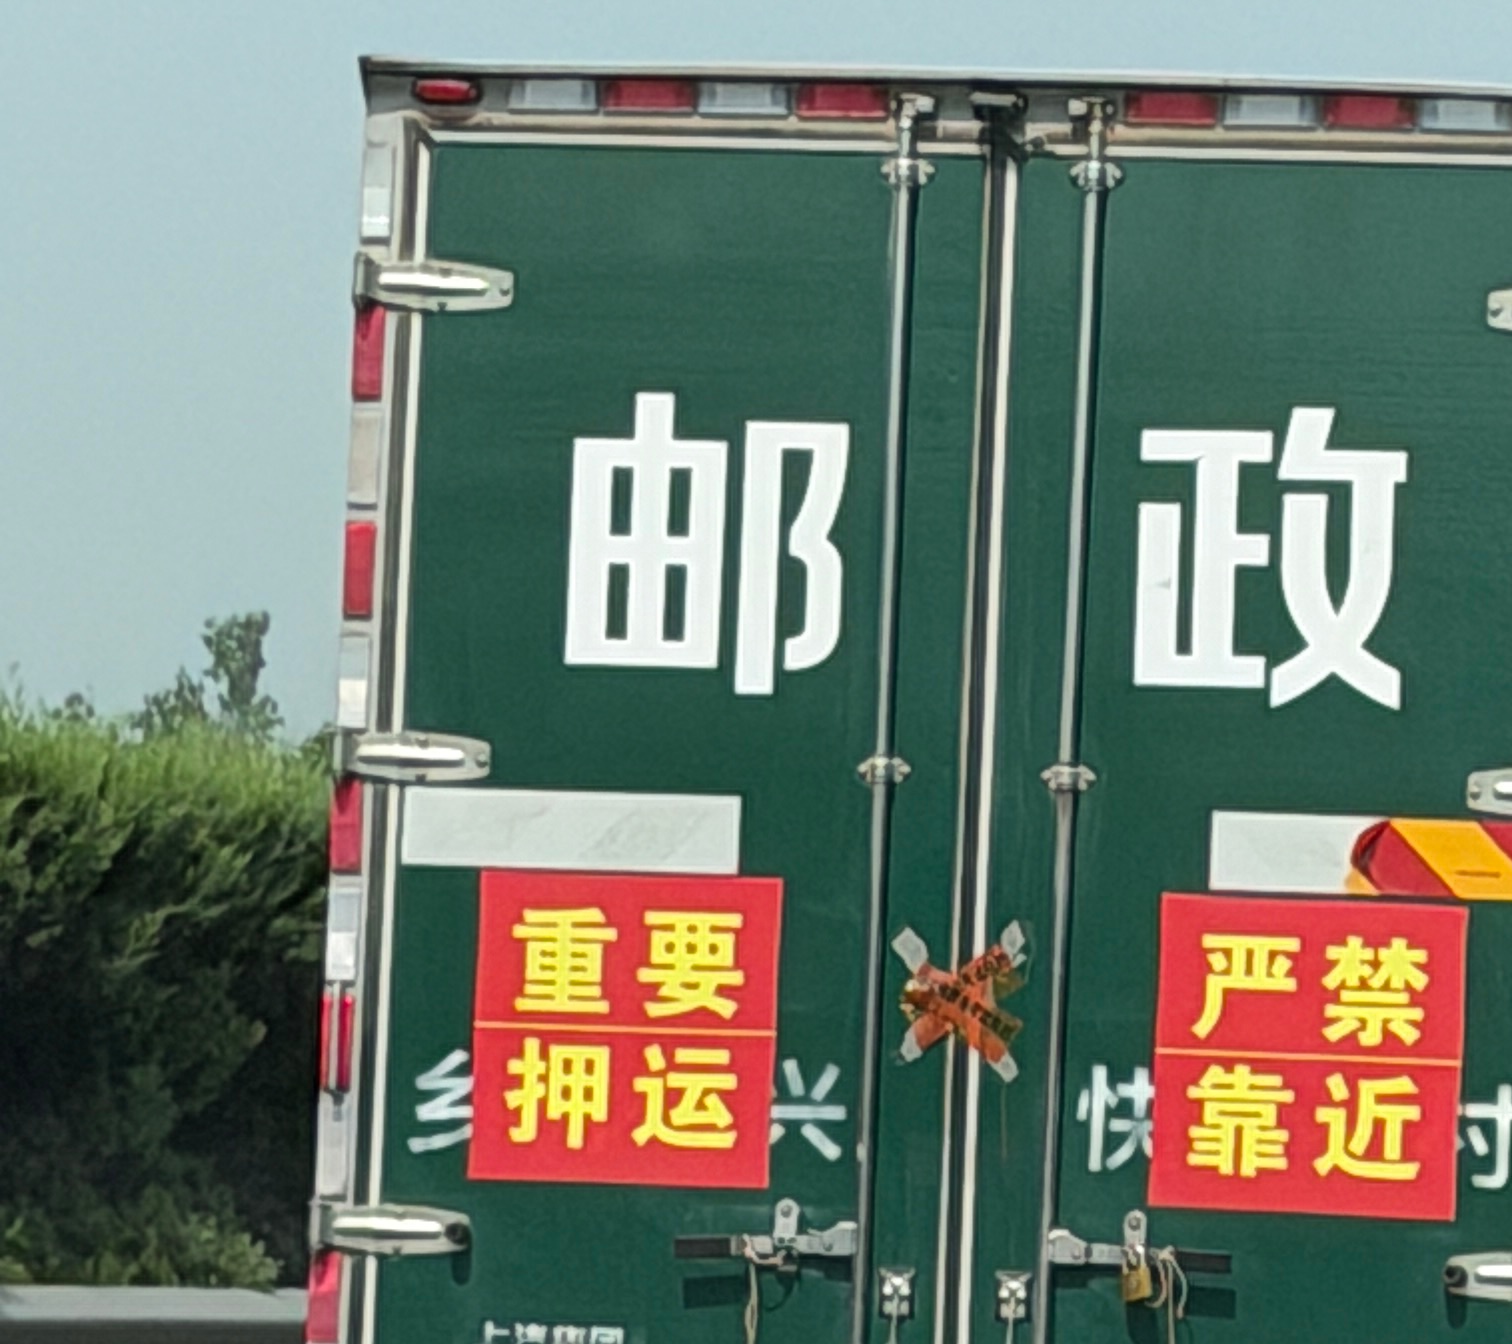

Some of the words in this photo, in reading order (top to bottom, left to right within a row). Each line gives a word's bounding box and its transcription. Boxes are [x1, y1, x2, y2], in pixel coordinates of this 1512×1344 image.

[512, 907, 744, 1019] 重要
[1191, 934, 1429, 1047] 严禁
[504, 1037, 738, 1150] 押运
[1186, 1063, 1422, 1181] 靠近
